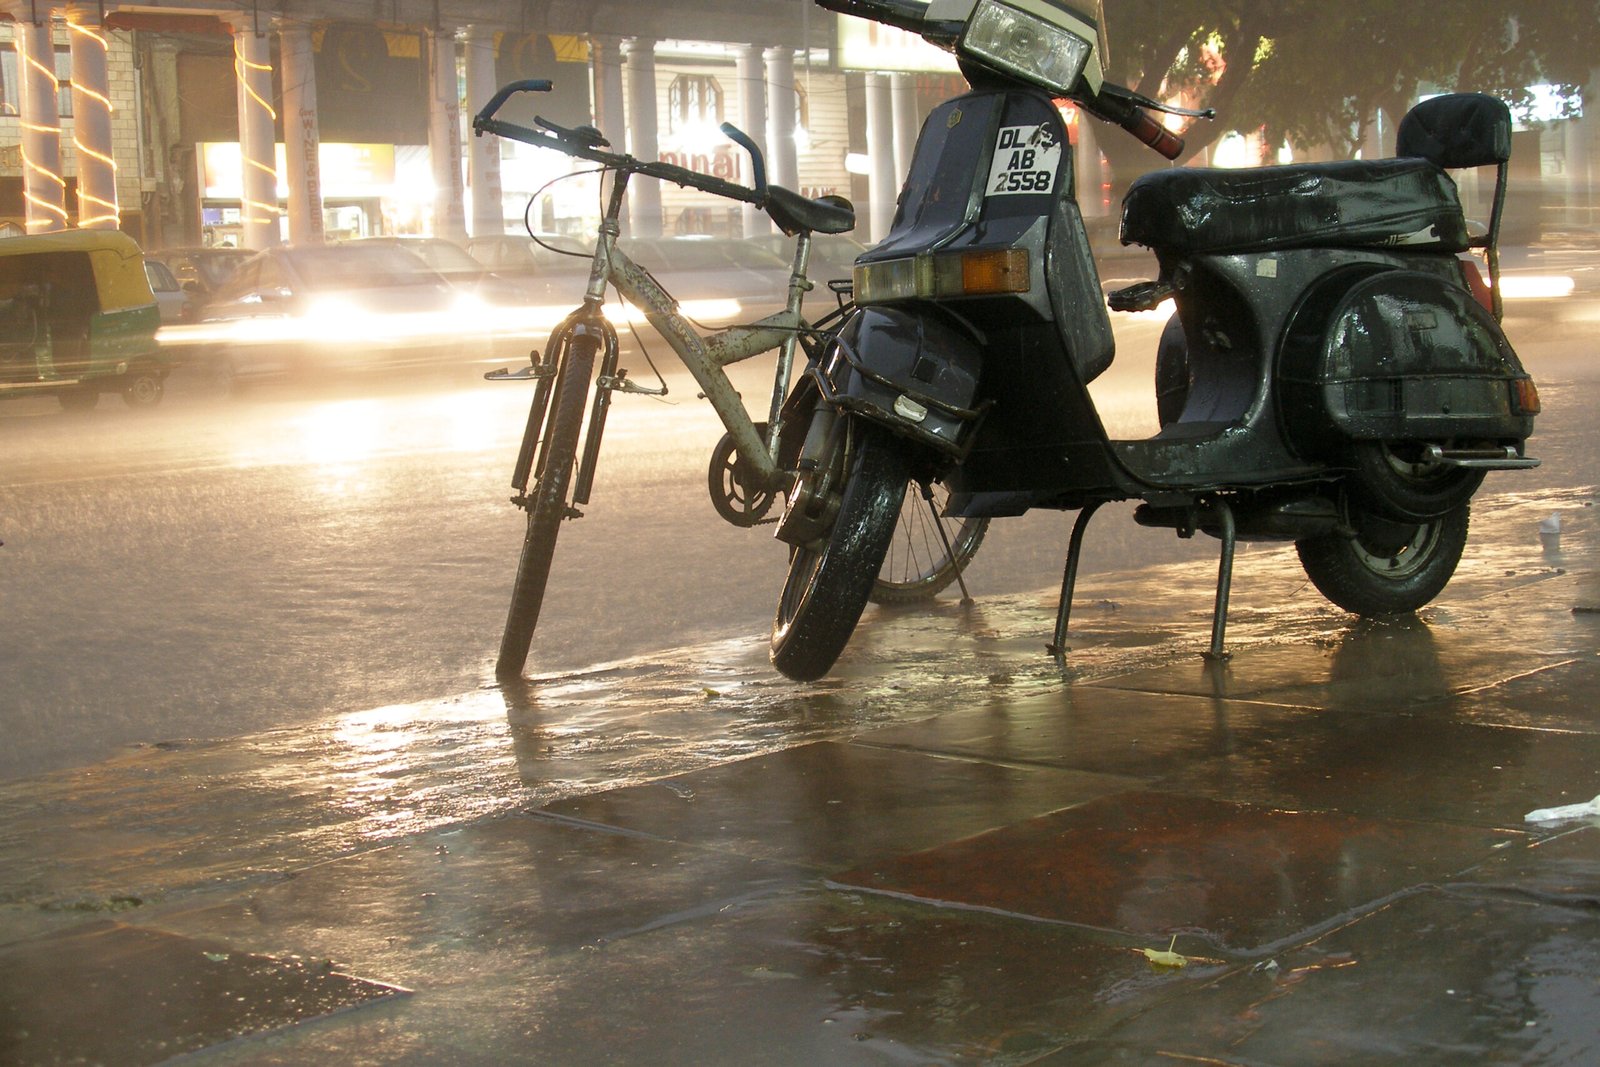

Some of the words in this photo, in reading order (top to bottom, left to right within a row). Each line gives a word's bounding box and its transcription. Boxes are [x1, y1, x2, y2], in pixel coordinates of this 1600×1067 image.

[303, 119, 315, 161] WINE
[998, 128, 1026, 150] DL
[1006, 148, 1036, 171] AB
[993, 170, 1052, 193] 2558
